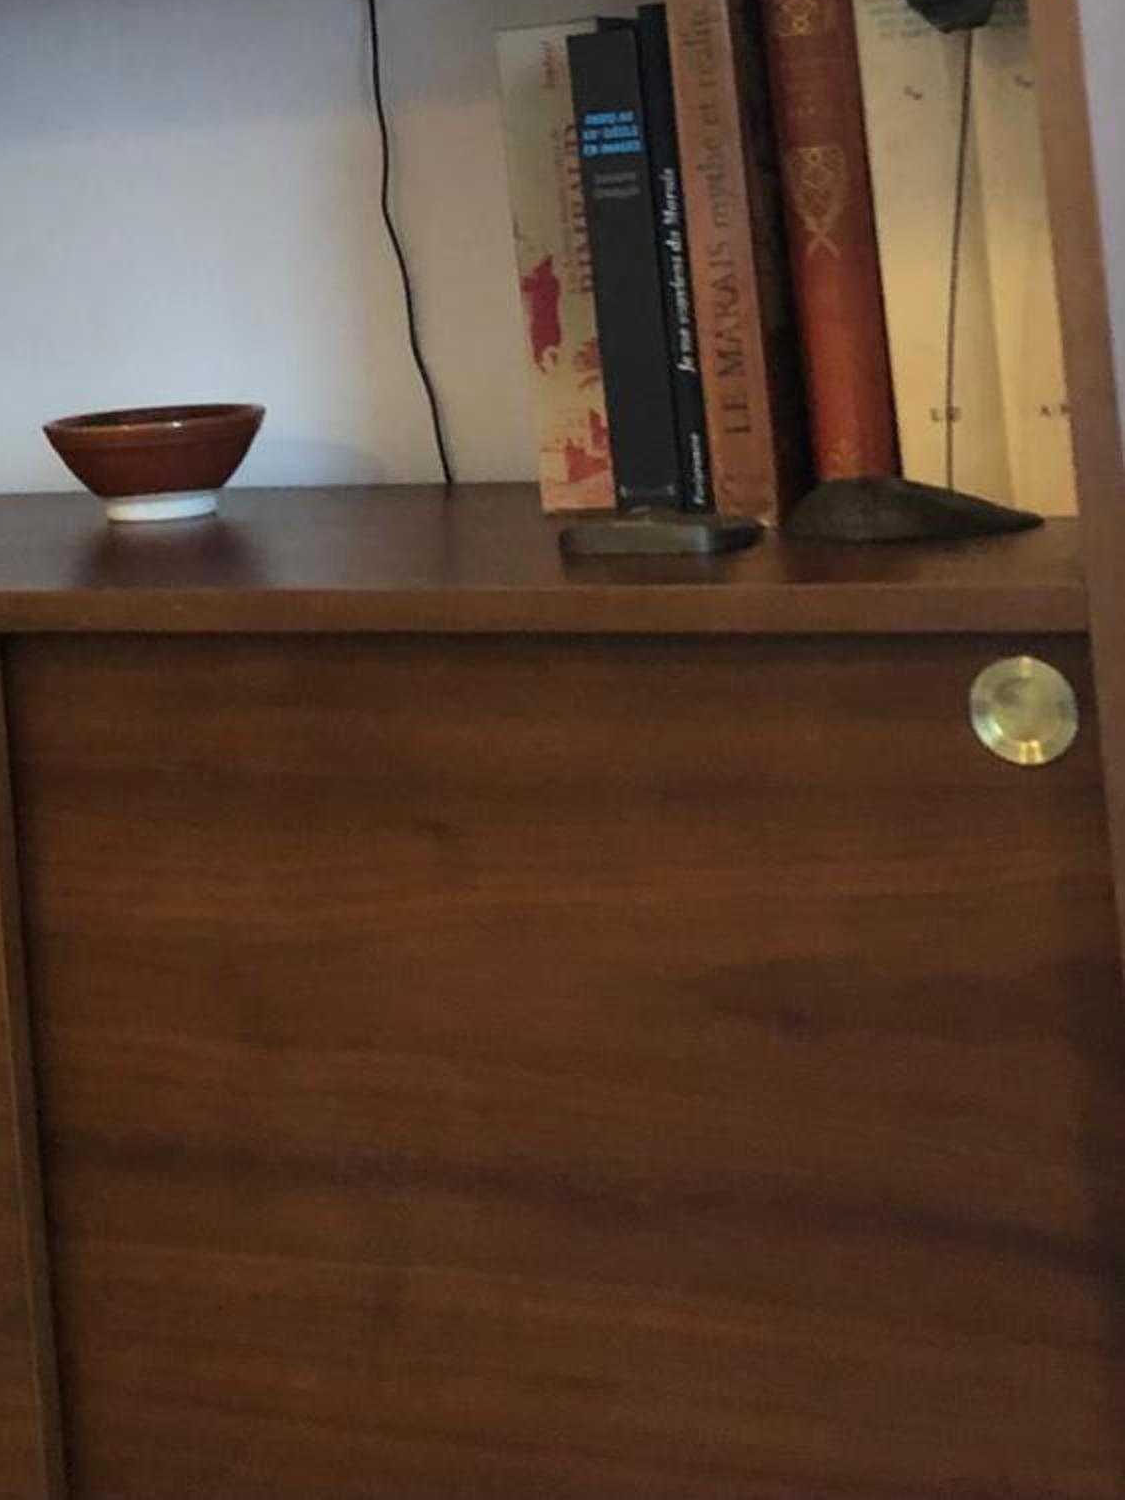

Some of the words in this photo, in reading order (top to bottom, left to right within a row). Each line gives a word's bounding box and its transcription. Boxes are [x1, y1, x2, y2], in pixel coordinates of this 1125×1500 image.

[695, 97, 716, 128] et
[697, 136, 732, 229] mythe
[711, 240, 745, 379] MARAIS
[720, 391, 751, 435] LE
